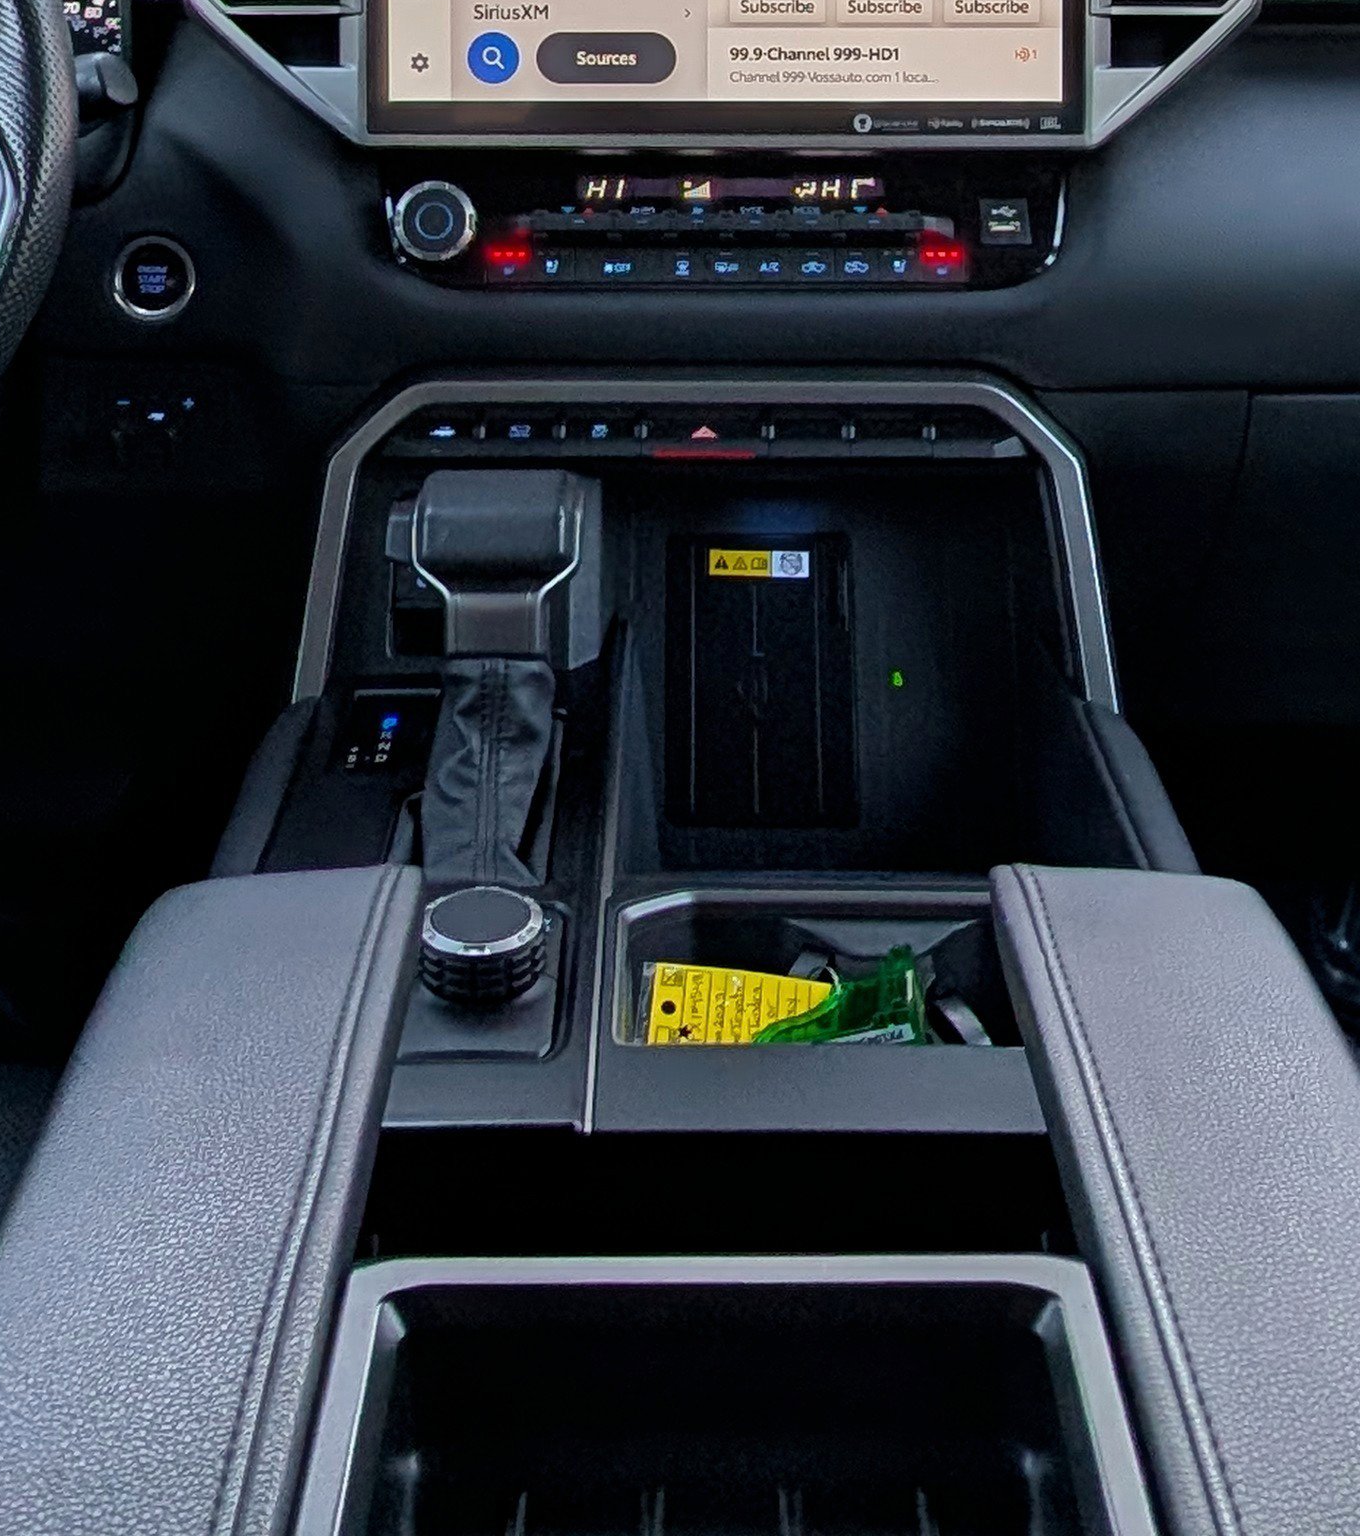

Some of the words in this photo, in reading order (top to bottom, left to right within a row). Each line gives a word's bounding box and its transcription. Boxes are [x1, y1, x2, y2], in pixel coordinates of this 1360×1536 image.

[64, 2, 80, 14] 70
[474, 4, 549, 20] SiriusXM
[740, 0, 815, 14] Subscribe
[848, 0, 922, 14] Subscribe
[955, 0, 1029, 14] Subscribe
[576, 50, 637, 66] Sources
[833, 47, 899, 61] 999-HD1
[586, 179, 625, 199] HI
